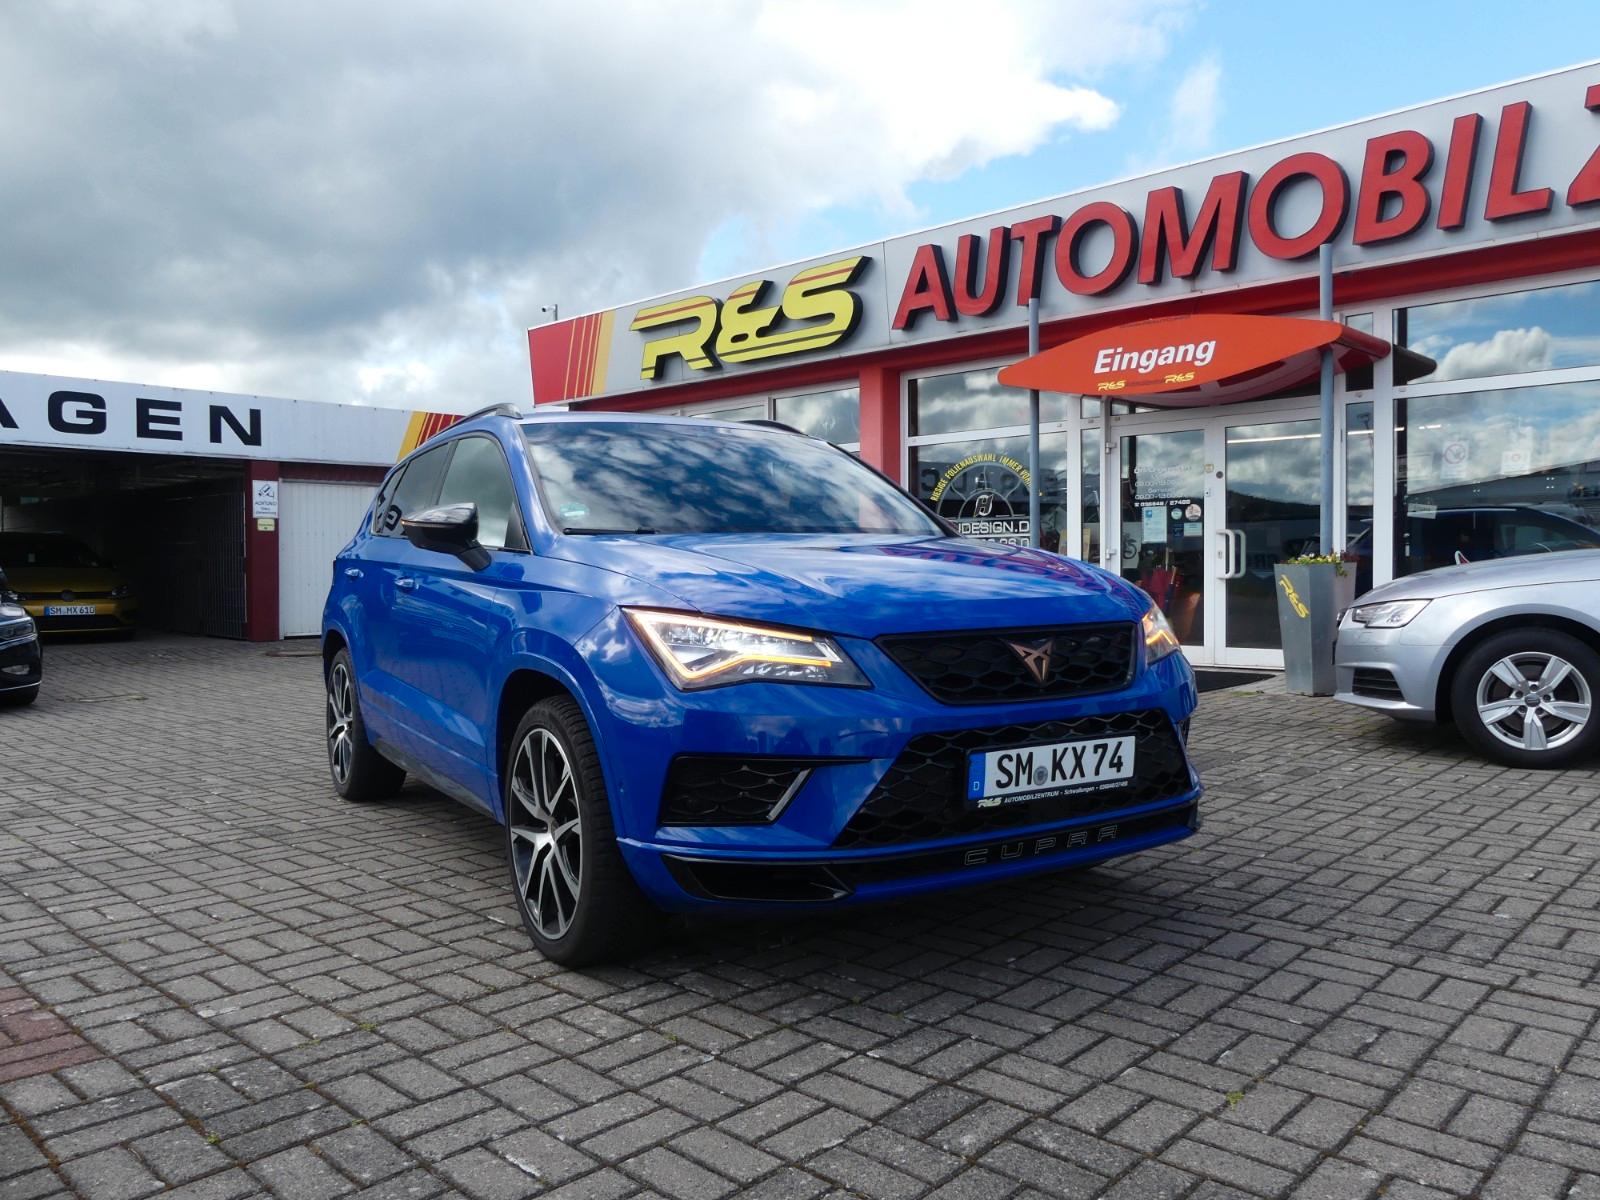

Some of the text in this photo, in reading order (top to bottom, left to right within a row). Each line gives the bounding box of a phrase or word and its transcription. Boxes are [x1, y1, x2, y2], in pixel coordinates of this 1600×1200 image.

[630, 256, 871, 380] R&S
[1094, 340, 1216, 374] Eingang
[930, 479, 948, 502] RIESIGE
[945, 453, 996, 480] FOLIENAUSWAHL
[999, 455, 1023, 472] IMMER
[996, 741, 1124, 789] SM KX 74
[973, 781, 980, 791] D
[1004, 790, 1060, 804] AUTOMOBILZENTRUM
[964, 825, 1118, 866] CUPRA
